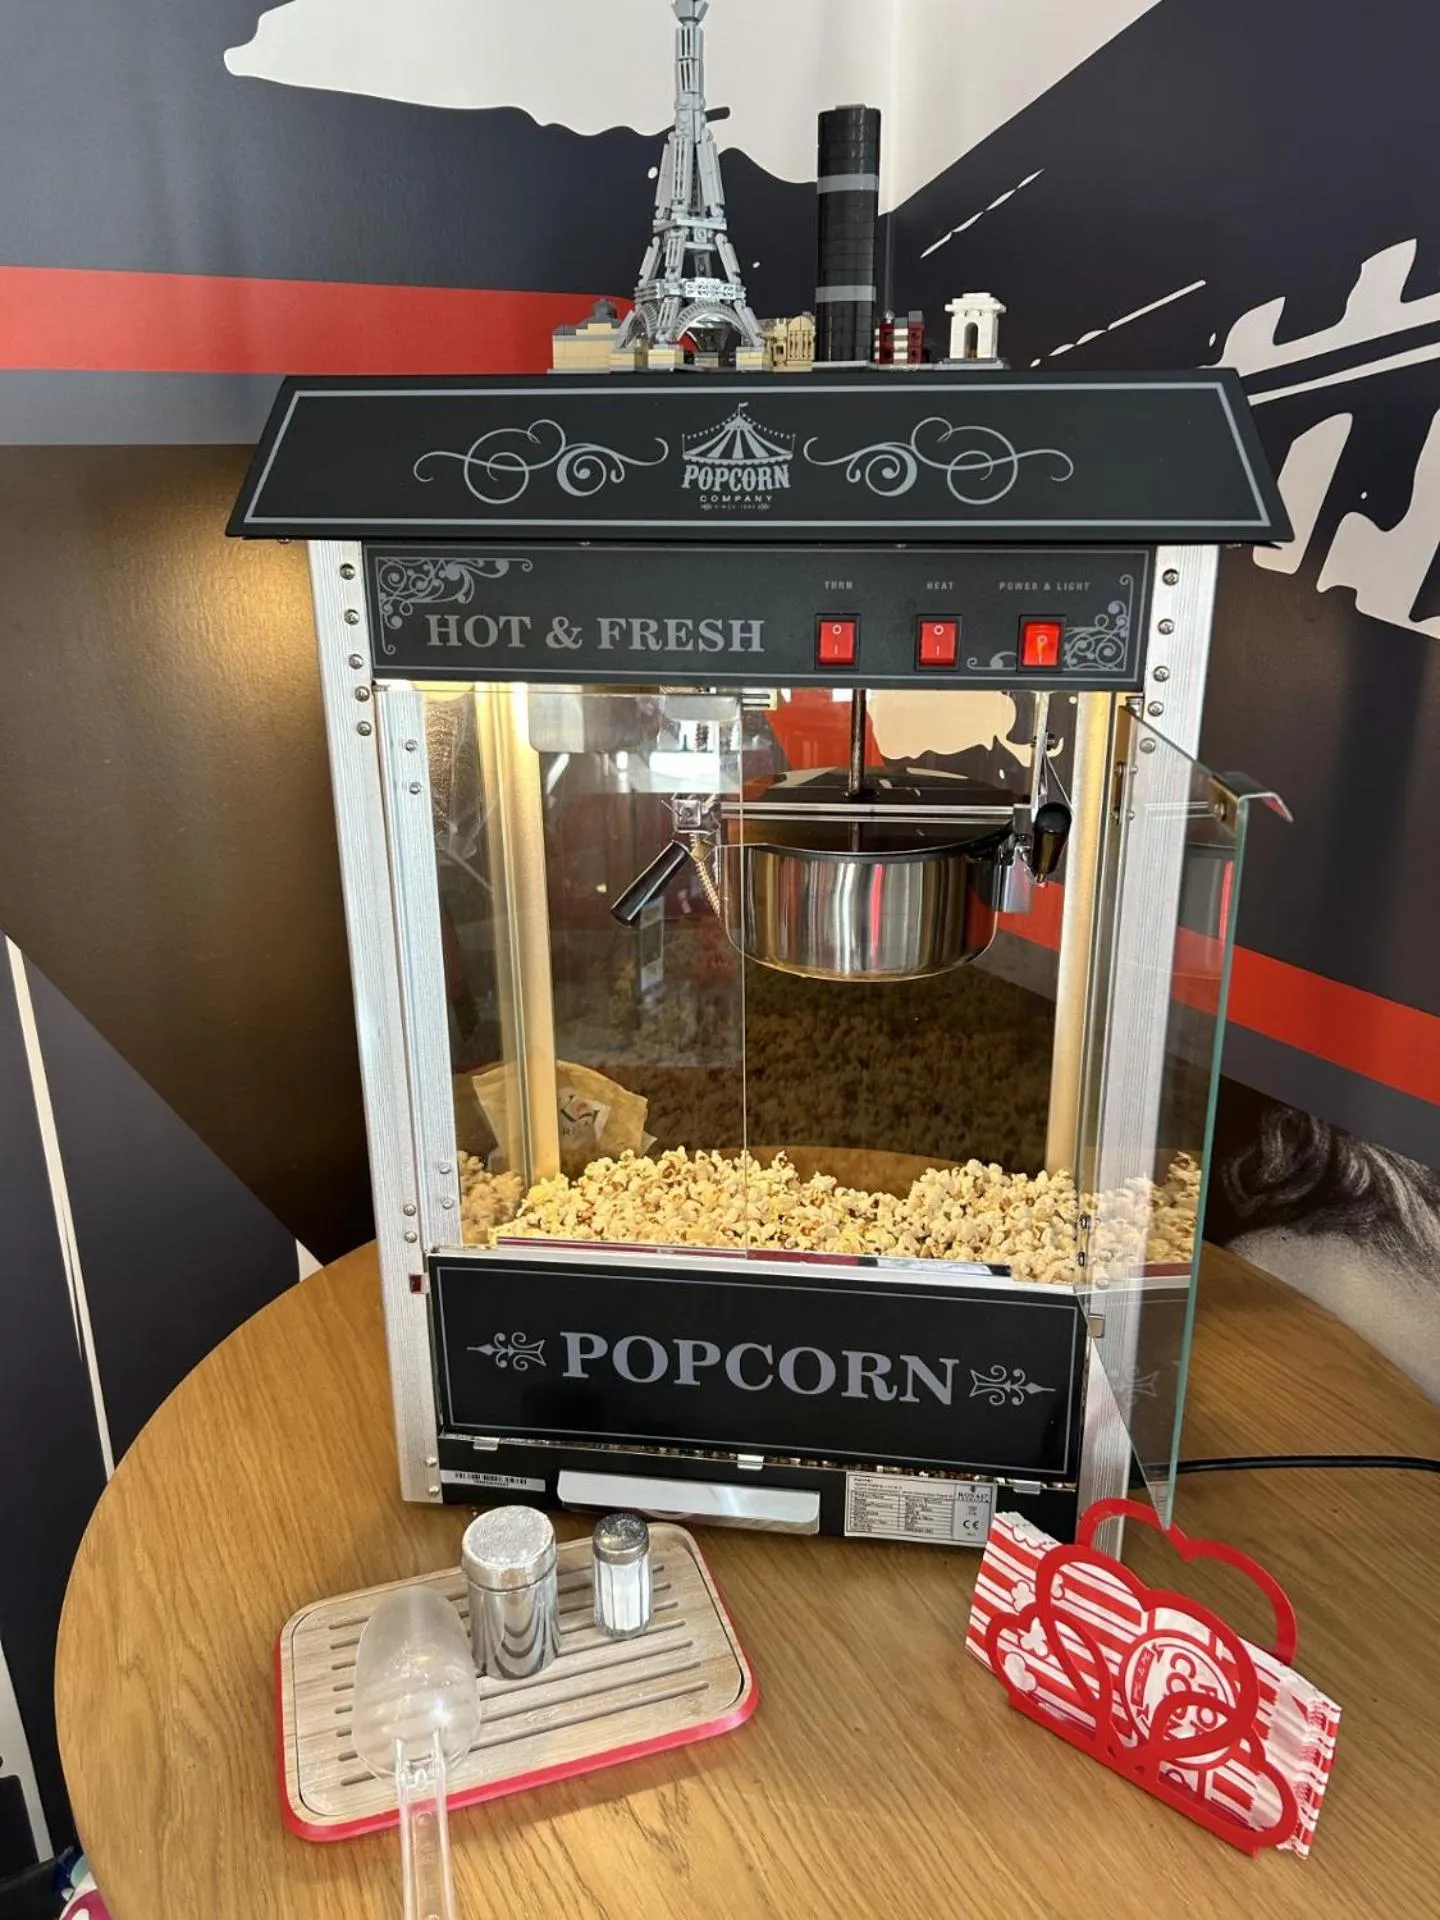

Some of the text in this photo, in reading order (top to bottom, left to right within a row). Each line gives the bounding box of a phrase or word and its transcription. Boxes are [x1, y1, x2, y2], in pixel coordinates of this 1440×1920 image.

[681, 464, 791, 492] POPCORN
[699, 495, 773, 503] COMPANY
[926, 581, 954, 590] HEAT
[998, 581, 1038, 591] POWER
[1056, 581, 1091, 591] LIGHT
[425, 614, 766, 653] HOT & FRESH
[560, 1332, 959, 1405] POPCORN
